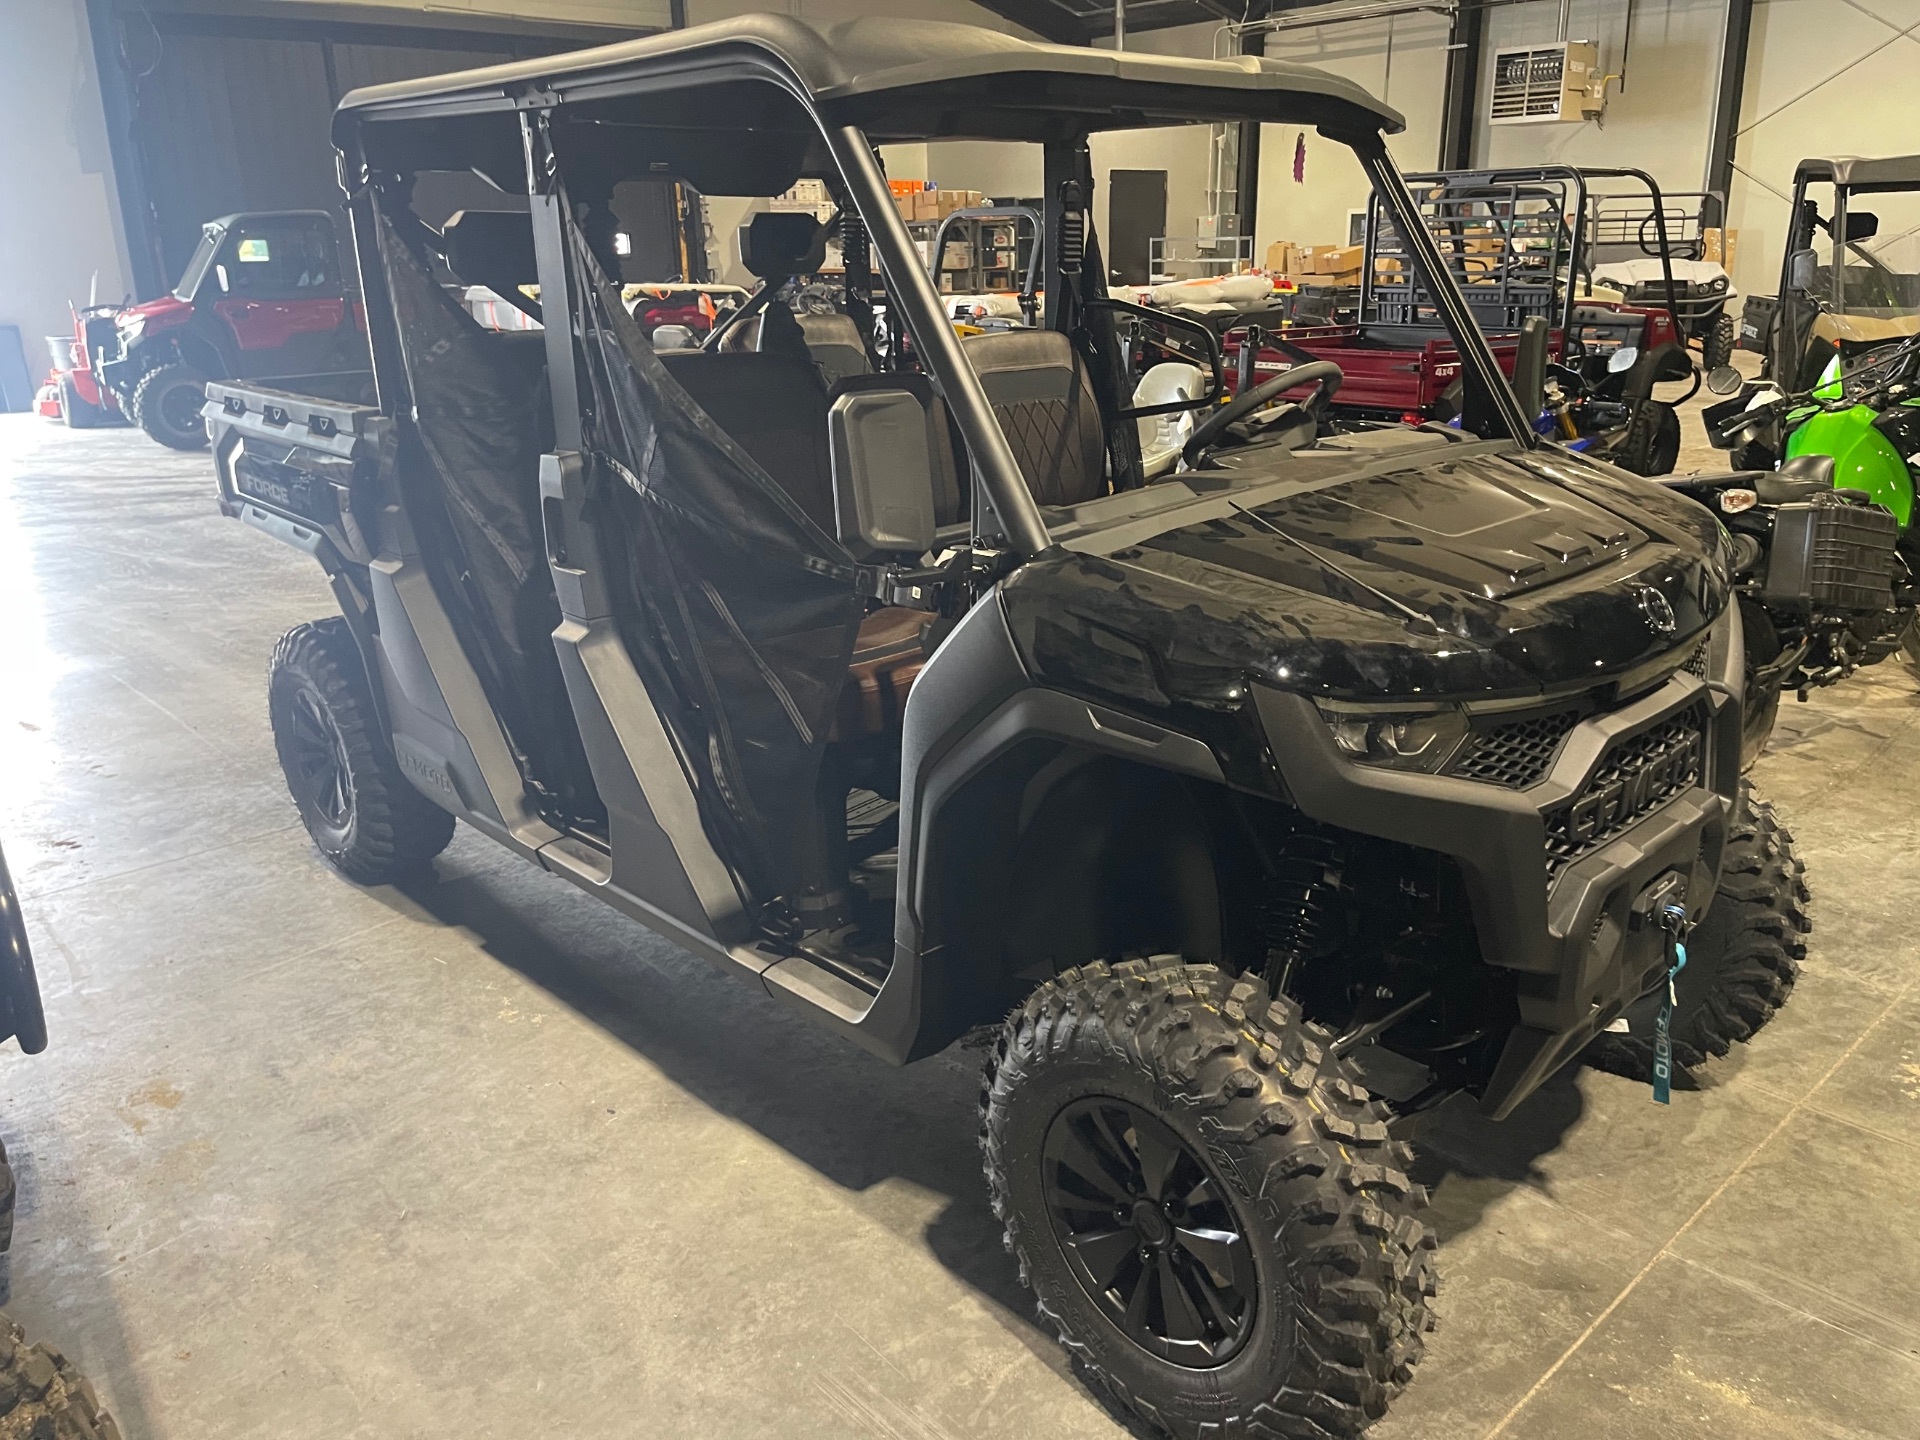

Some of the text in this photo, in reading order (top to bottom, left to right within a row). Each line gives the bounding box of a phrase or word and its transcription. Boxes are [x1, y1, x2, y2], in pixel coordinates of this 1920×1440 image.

[1434, 366, 1454, 377] 4x4
[246, 474, 291, 504] FORCE
[1569, 730, 1701, 844] CFMOTO
[1655, 1005, 1669, 1080] CFMOTO
